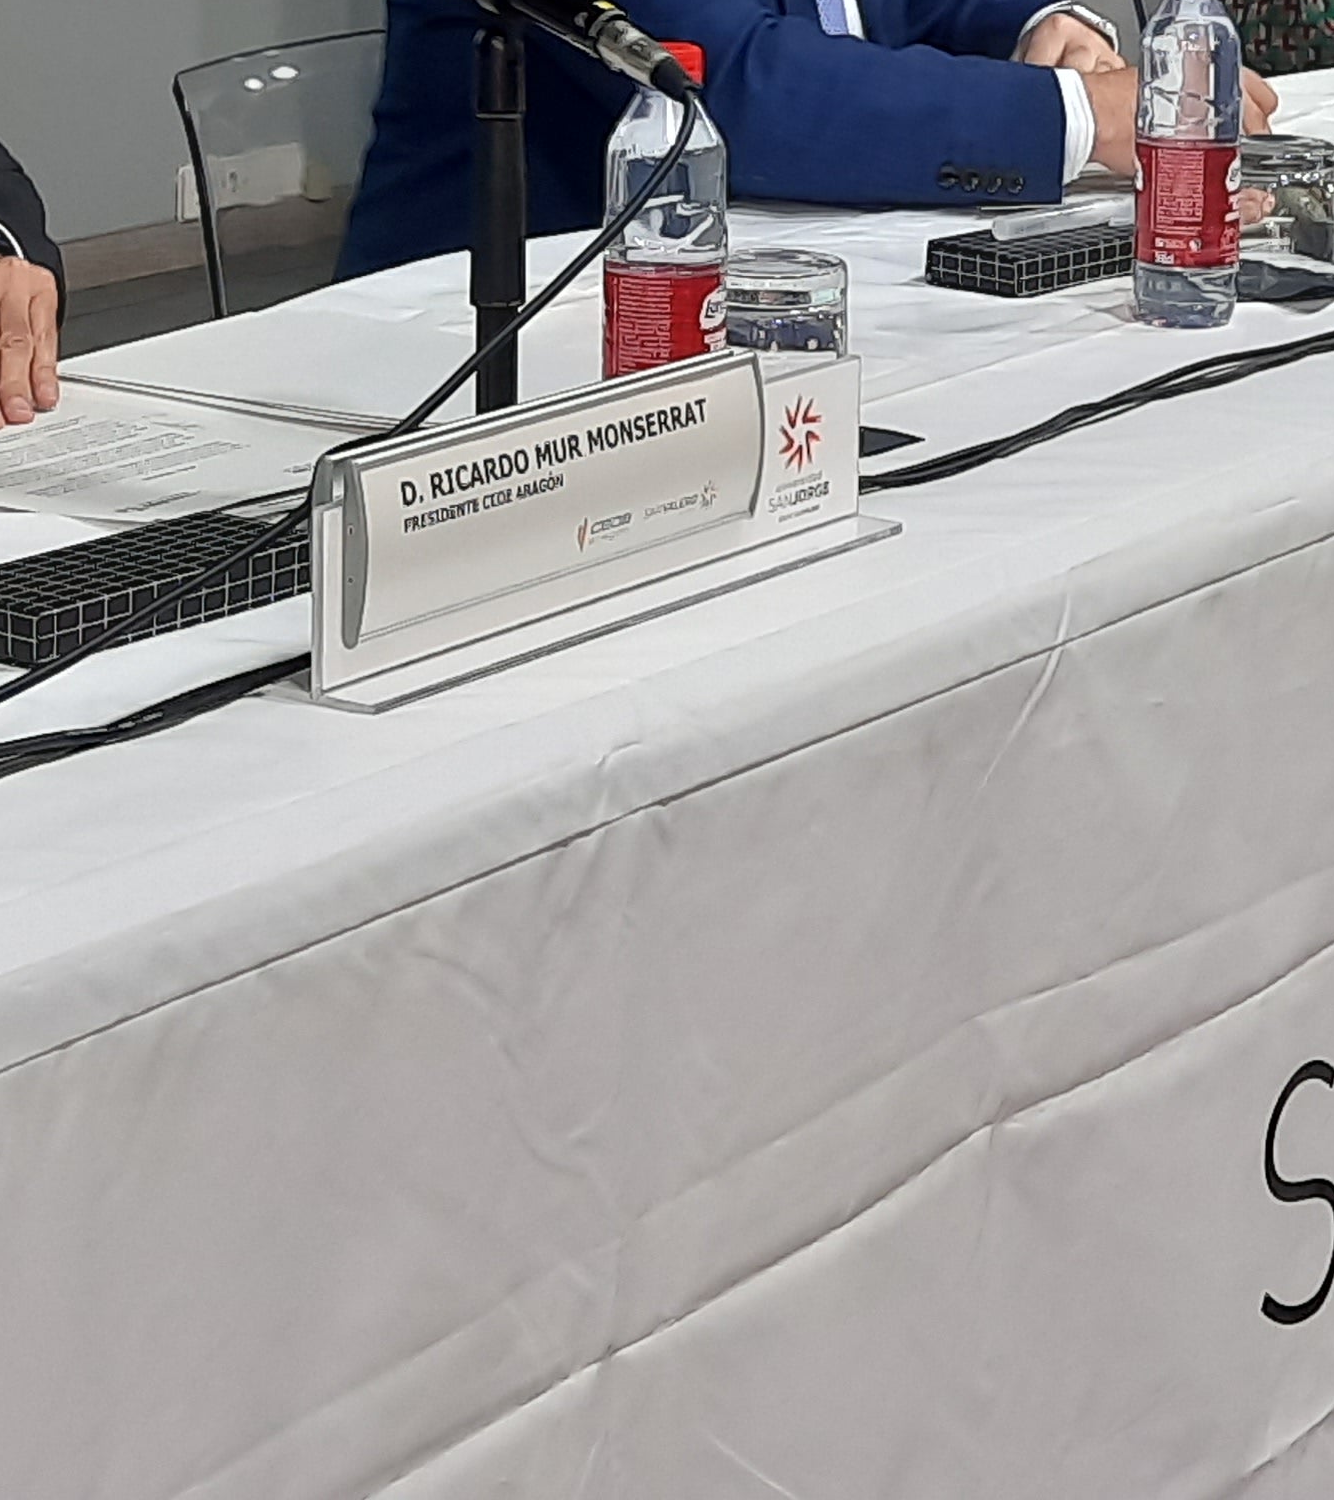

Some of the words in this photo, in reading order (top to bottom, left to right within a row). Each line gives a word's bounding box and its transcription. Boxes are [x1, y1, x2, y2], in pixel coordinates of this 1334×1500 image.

[430, 449, 530, 499] RICARDO
[535, 434, 583, 469] MUR
[586, 398, 707, 454] MONSERRAT
[403, 498, 480, 534] PRESIDENTE
[516, 470, 565, 500] ARAGÓN
